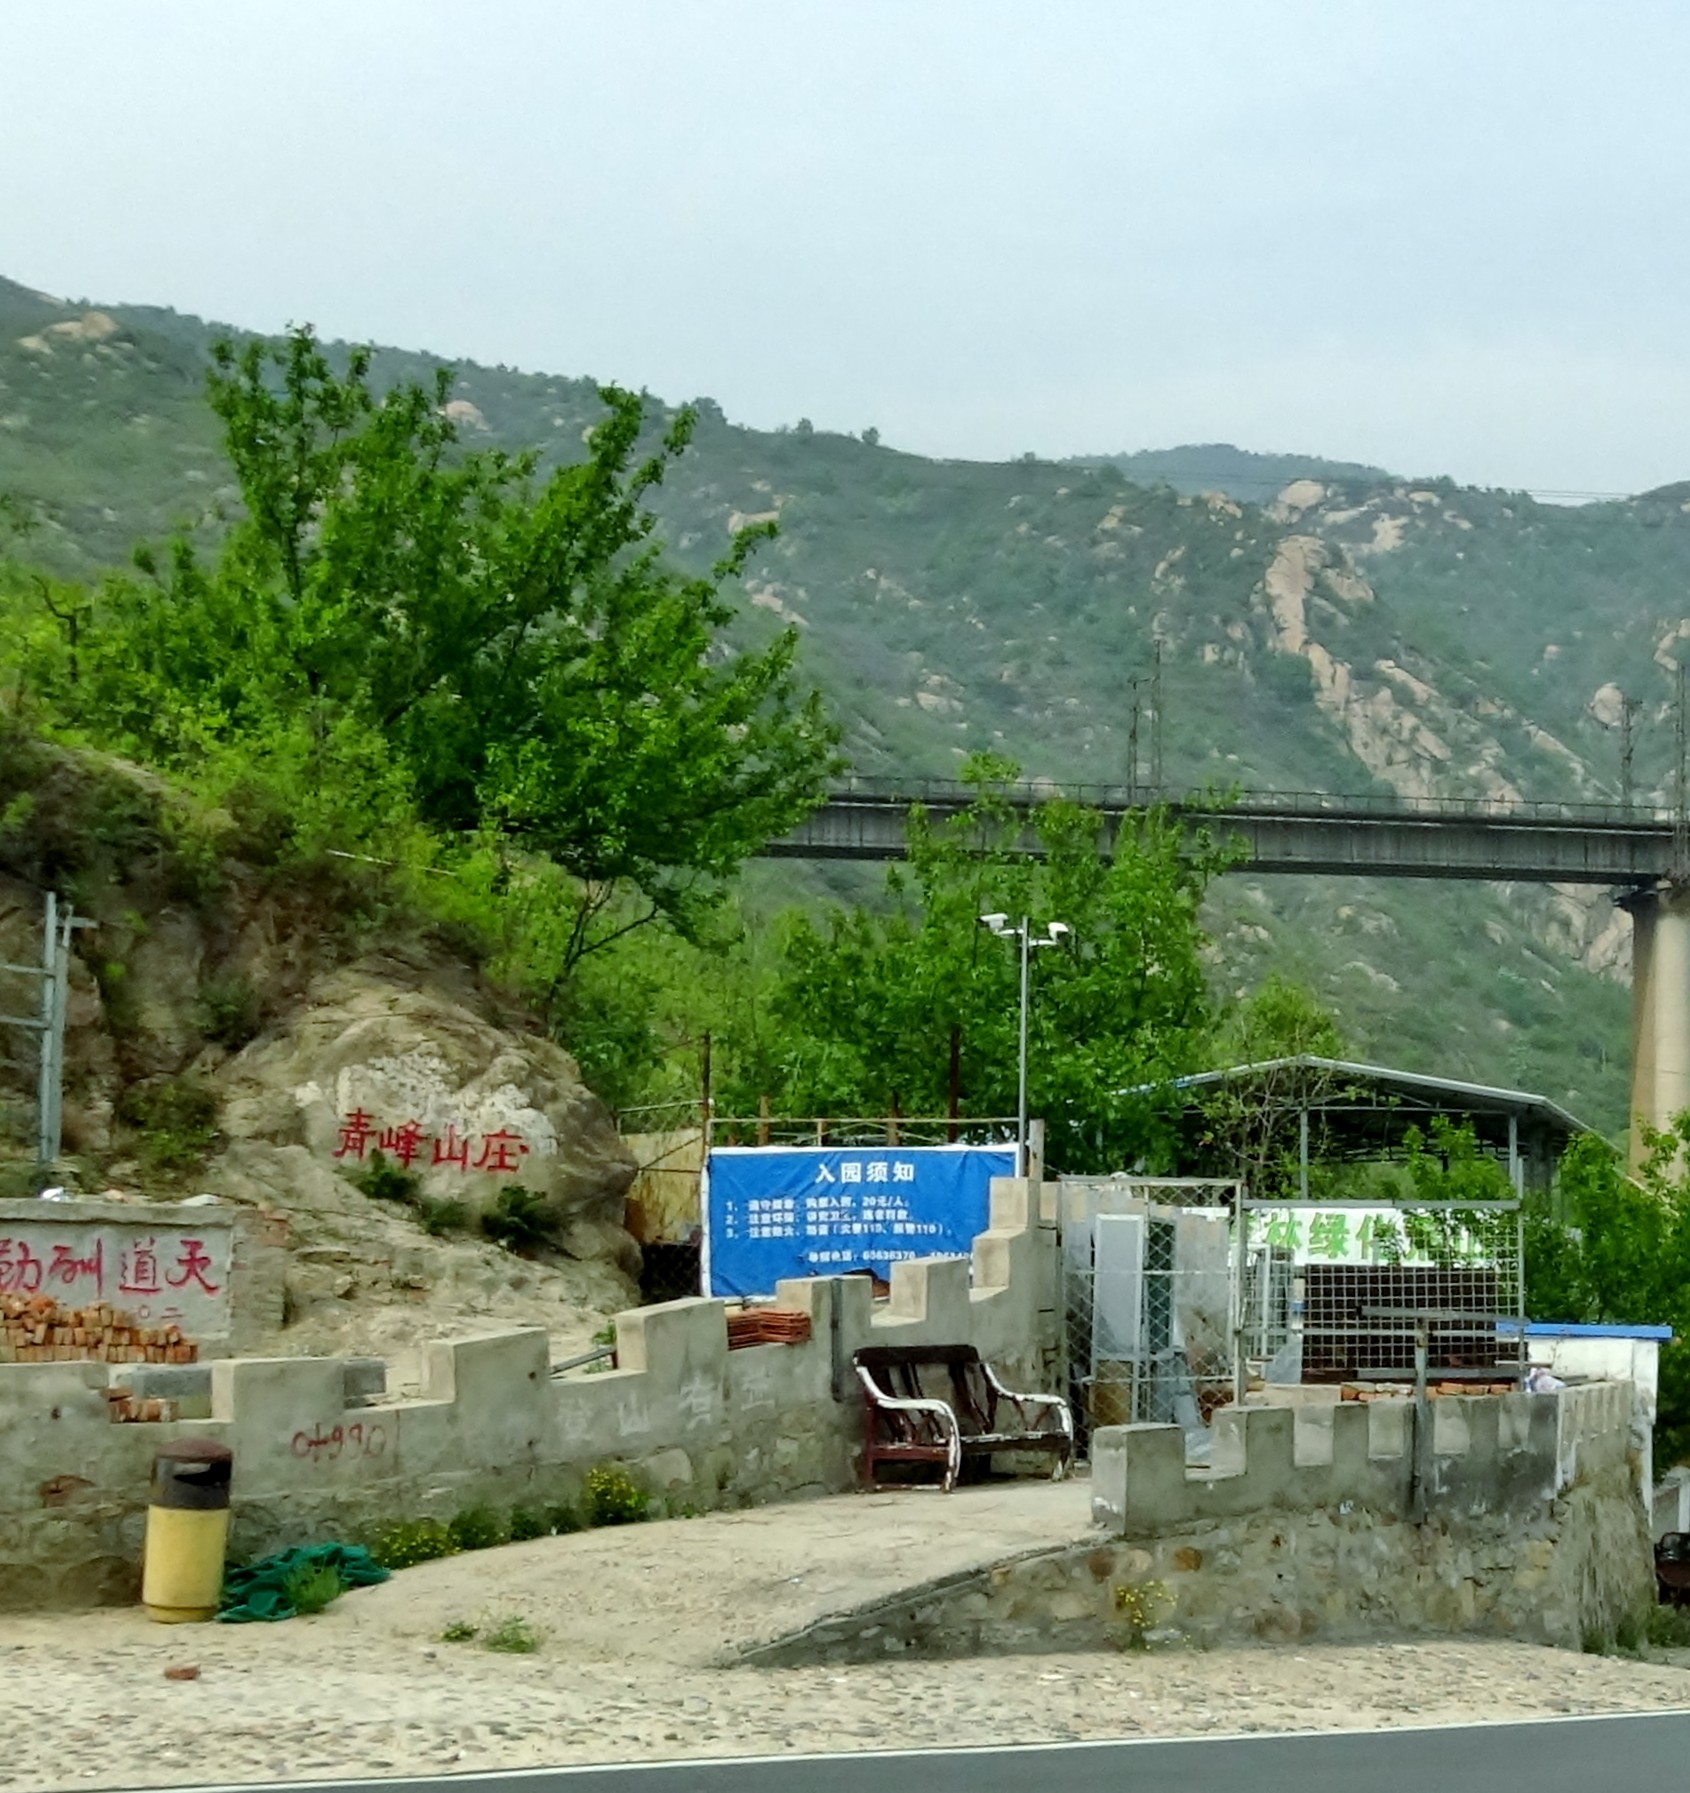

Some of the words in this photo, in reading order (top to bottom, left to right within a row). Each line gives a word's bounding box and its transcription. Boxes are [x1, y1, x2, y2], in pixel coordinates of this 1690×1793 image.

[332, 1107, 529, 1173] 青峰山庄
[815, 1160, 914, 1184] 入园须知
